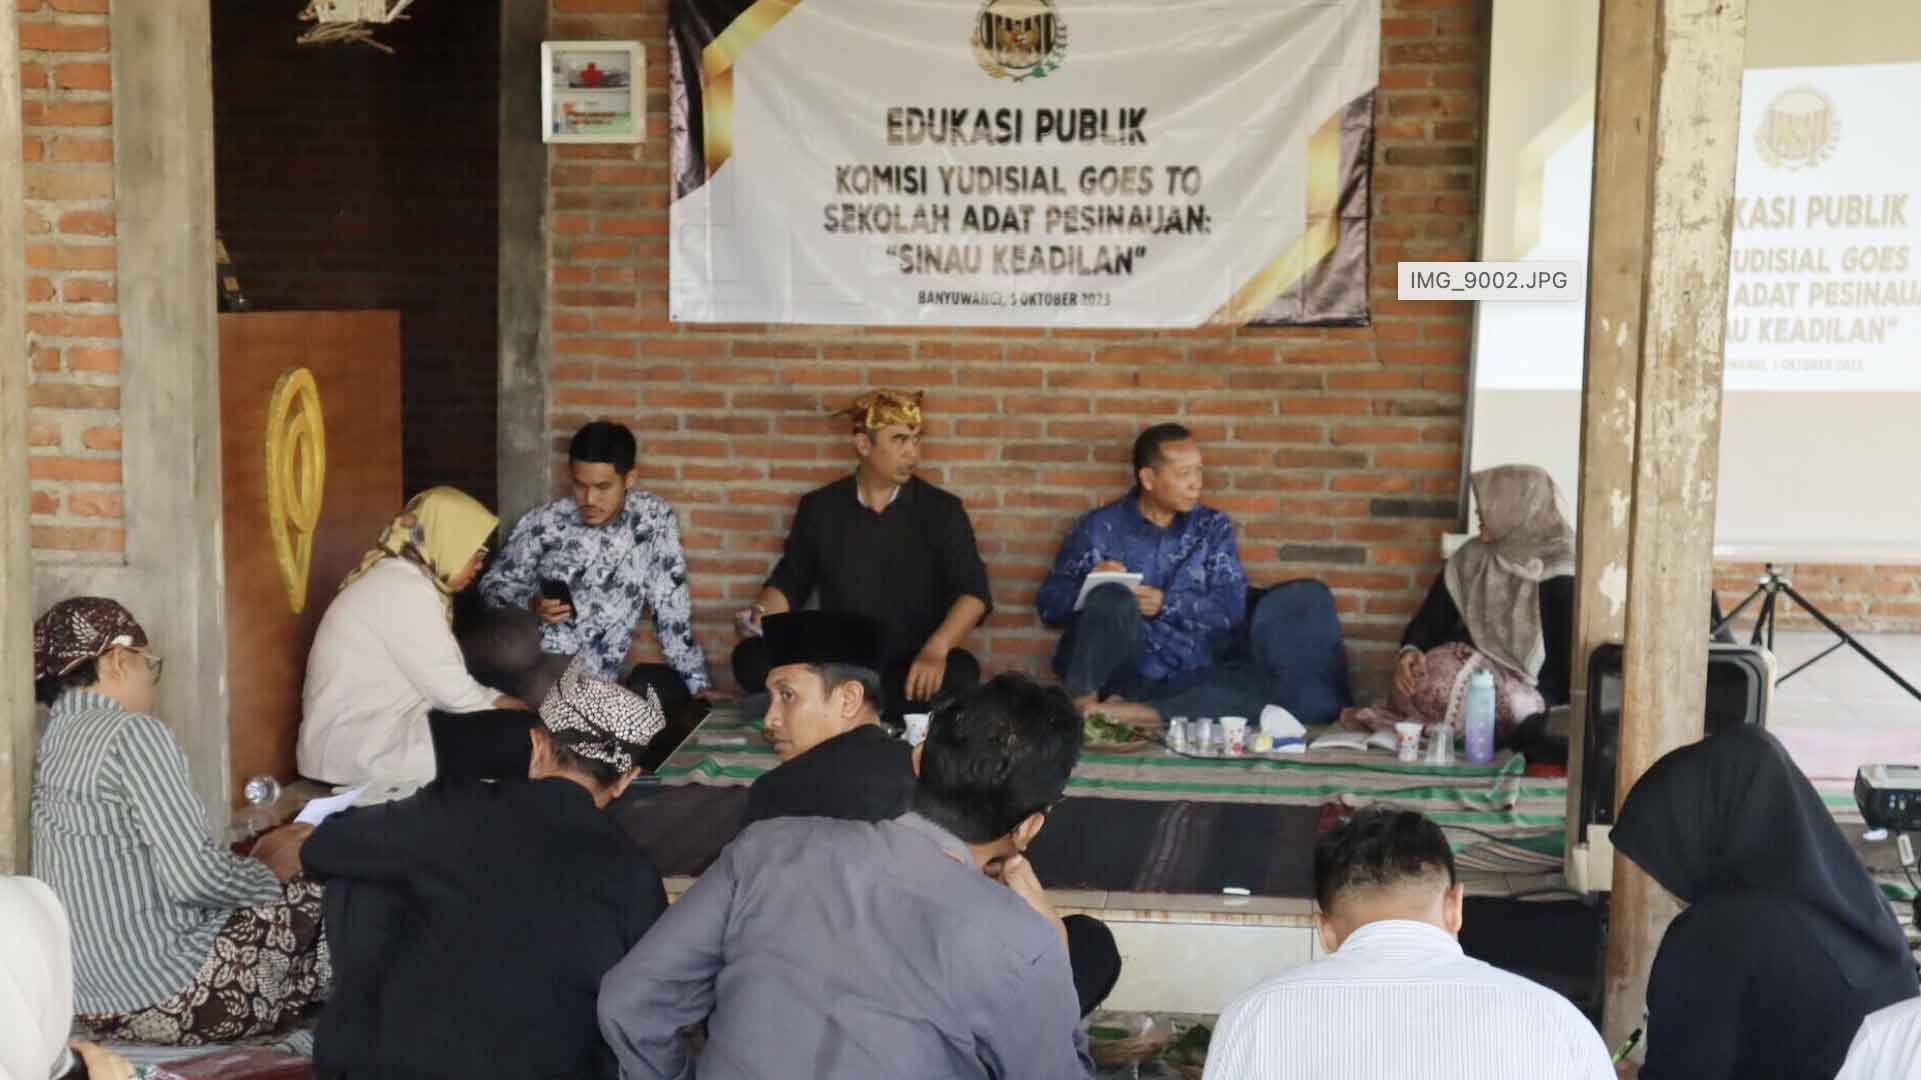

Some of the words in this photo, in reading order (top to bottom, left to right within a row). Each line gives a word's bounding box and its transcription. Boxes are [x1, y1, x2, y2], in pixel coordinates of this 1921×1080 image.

[886, 107, 1023, 145] EDUKASI
[1035, 107, 1148, 145] PUBLIK
[835, 164, 928, 196] KOMISI
[938, 164, 1067, 196] YUDISIAL
[1078, 164, 1154, 196] GOES
[1165, 164, 1201, 196] TO
[823, 203, 951, 235] SEKOLAH
[962, 203, 1035, 235] ADAT
[1044, 203, 1213, 235] PESINAUAN:
[1734, 195, 1796, 230] KASI
[1806, 193, 1910, 229] PUBLIK
[1733, 247, 1830, 274] UDISIAL
[1840, 244, 1912, 274] GOES
[1019, 291, 1079, 307] OKTOBER
[1080, 292, 1112, 306] 2023
[1733, 280, 1801, 308] ADAT
[1808, 279, 1921, 308] PESINAU
